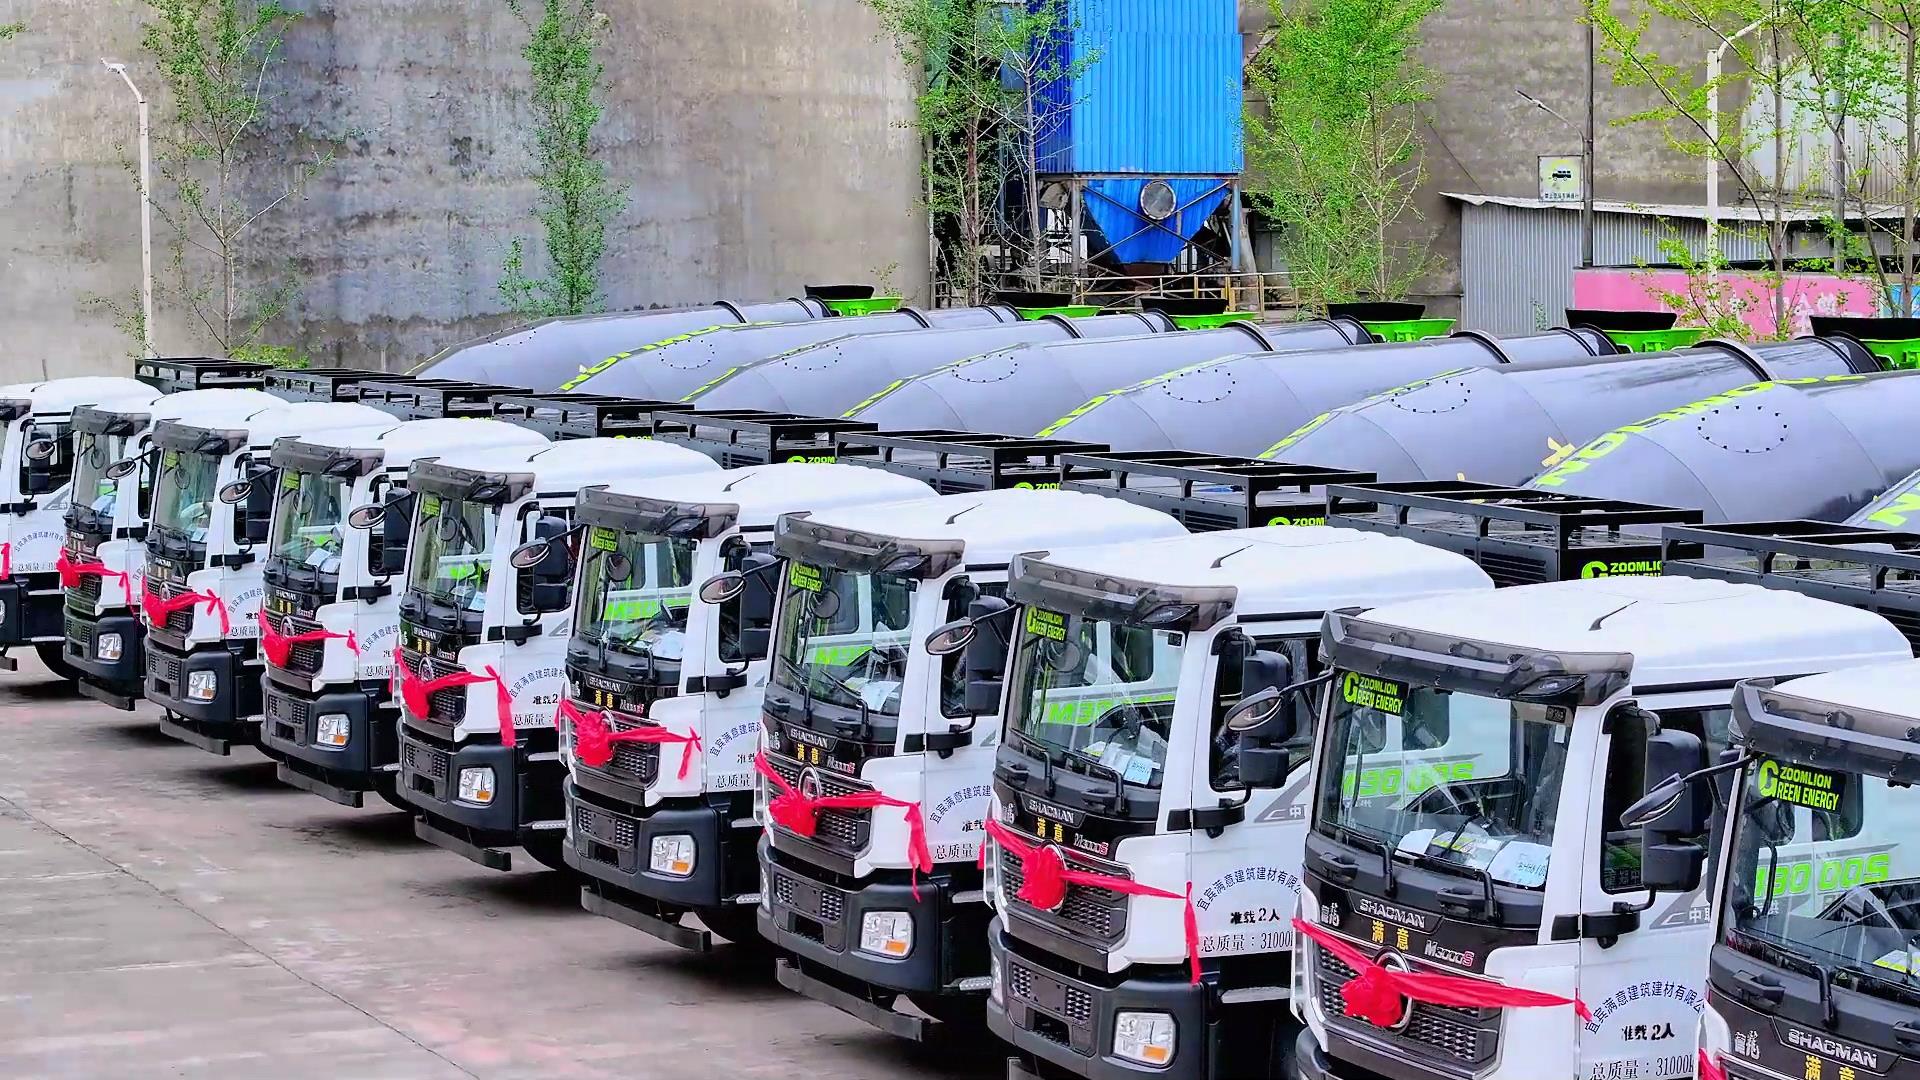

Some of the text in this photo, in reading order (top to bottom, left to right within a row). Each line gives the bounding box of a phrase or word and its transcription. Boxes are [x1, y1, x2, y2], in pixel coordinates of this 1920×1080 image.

[1360, 677, 1398, 695] ZOOMLION
[1375, 693, 1404, 714] ENERGY
[1780, 766, 1832, 790] ZOOMLION
[1029, 799, 1074, 824] SHACMAN
[1801, 787, 1840, 811] ENERGY
[1360, 898, 1426, 929] SHACMAN
[1371, 920, 1410, 952] 满意
[1425, 939, 1475, 967] M3000S
[1788, 1028, 1878, 1069] SHACMAN
